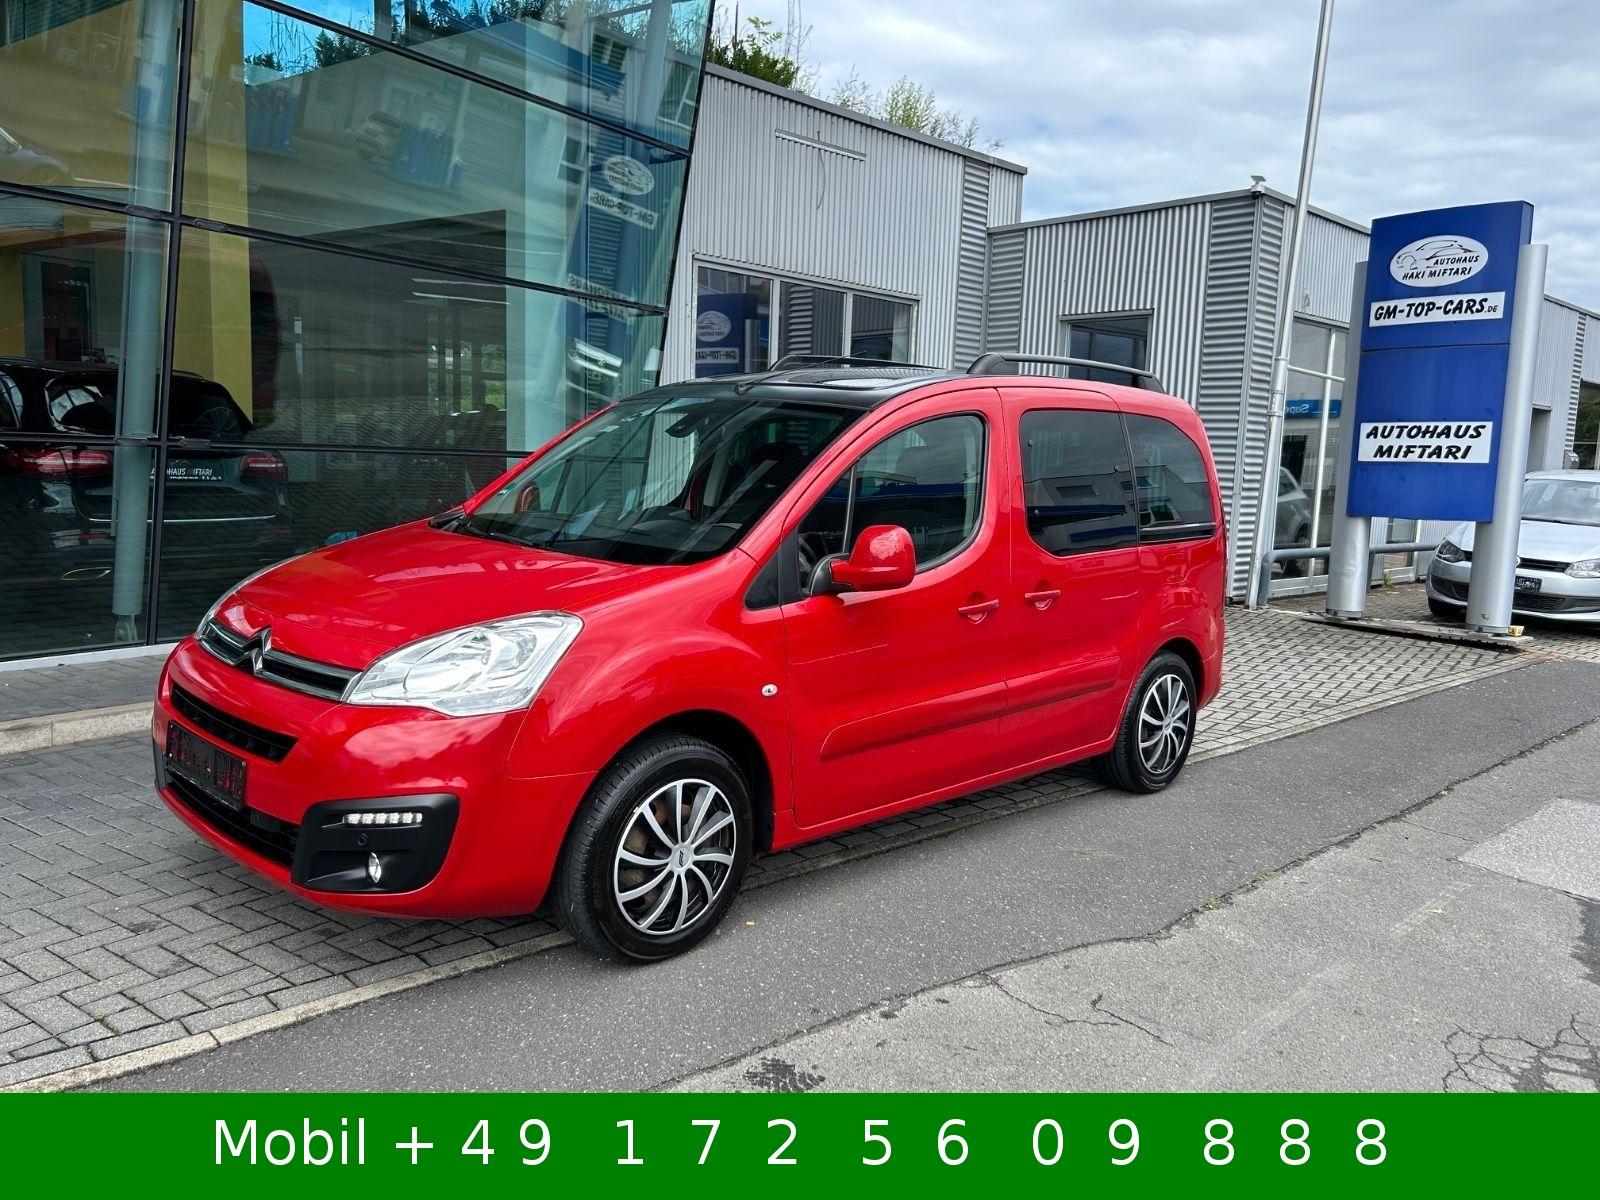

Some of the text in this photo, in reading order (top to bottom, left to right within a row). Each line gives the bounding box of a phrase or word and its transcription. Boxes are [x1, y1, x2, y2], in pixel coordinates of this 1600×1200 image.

[1433, 255, 1480, 266] AUTOHAUS
[1402, 266, 1472, 281] HAKI MIFTARI
[1365, 425, 1486, 439] AUTOHAUS
[1373, 445, 1472, 460] MIFTARI
[151, 468, 186, 476] AHAUS
